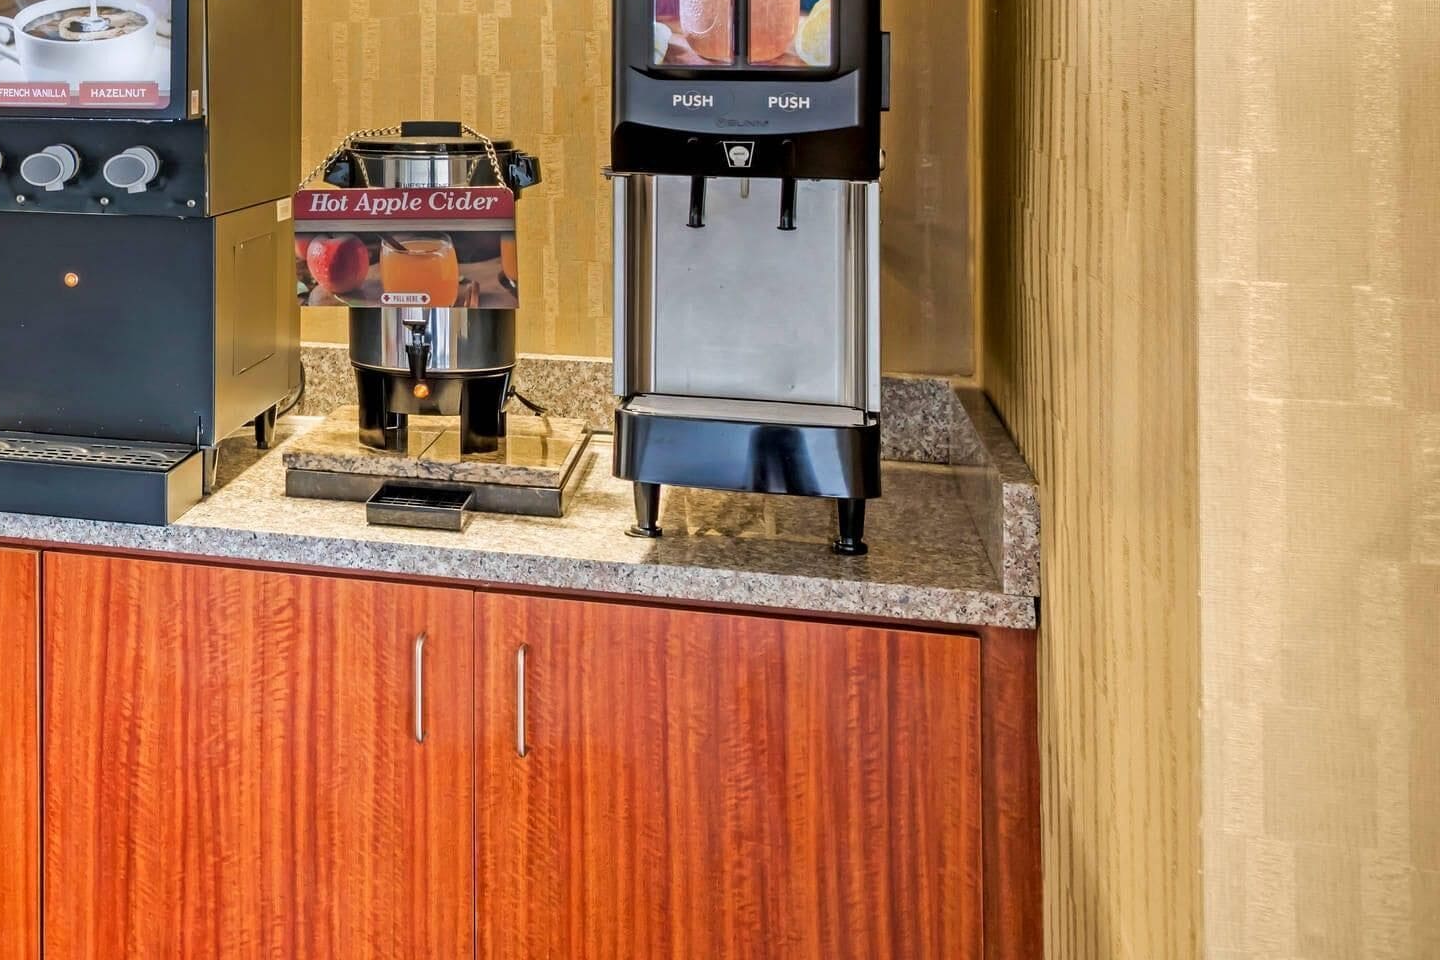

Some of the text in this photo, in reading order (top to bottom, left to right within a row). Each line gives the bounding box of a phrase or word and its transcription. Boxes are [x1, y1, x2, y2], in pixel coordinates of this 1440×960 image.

[32, 88, 67, 99] VANILLA
[90, 88, 147, 98] HAZELNUT
[672, 94, 713, 107] PUSH
[767, 96, 810, 109] PUSH
[309, 192, 349, 212] Hot
[354, 191, 422, 215] Apple
[428, 191, 499, 211] Cider
